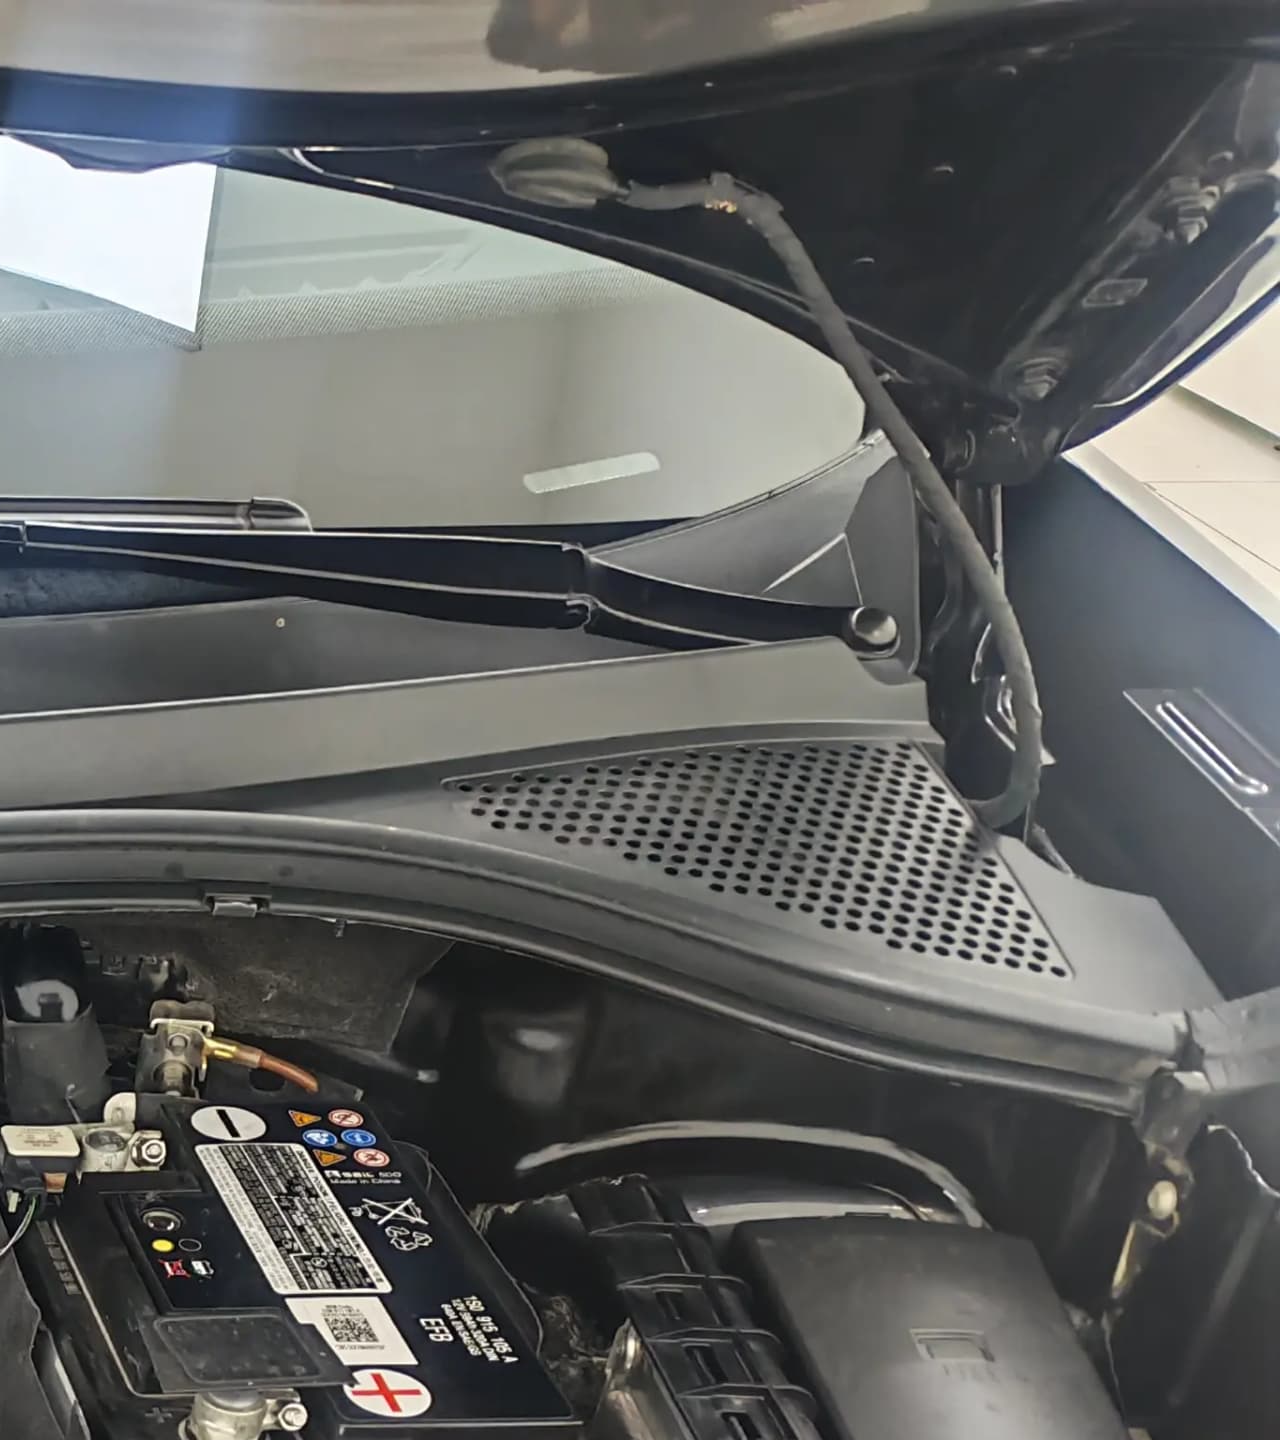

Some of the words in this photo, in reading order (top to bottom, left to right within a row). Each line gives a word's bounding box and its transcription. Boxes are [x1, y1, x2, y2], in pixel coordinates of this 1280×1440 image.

[420, 1318, 454, 1342] EFB
[475, 1316, 499, 1332] 915
[490, 1337, 513, 1353] 105
[501, 1355, 519, 1363] A
